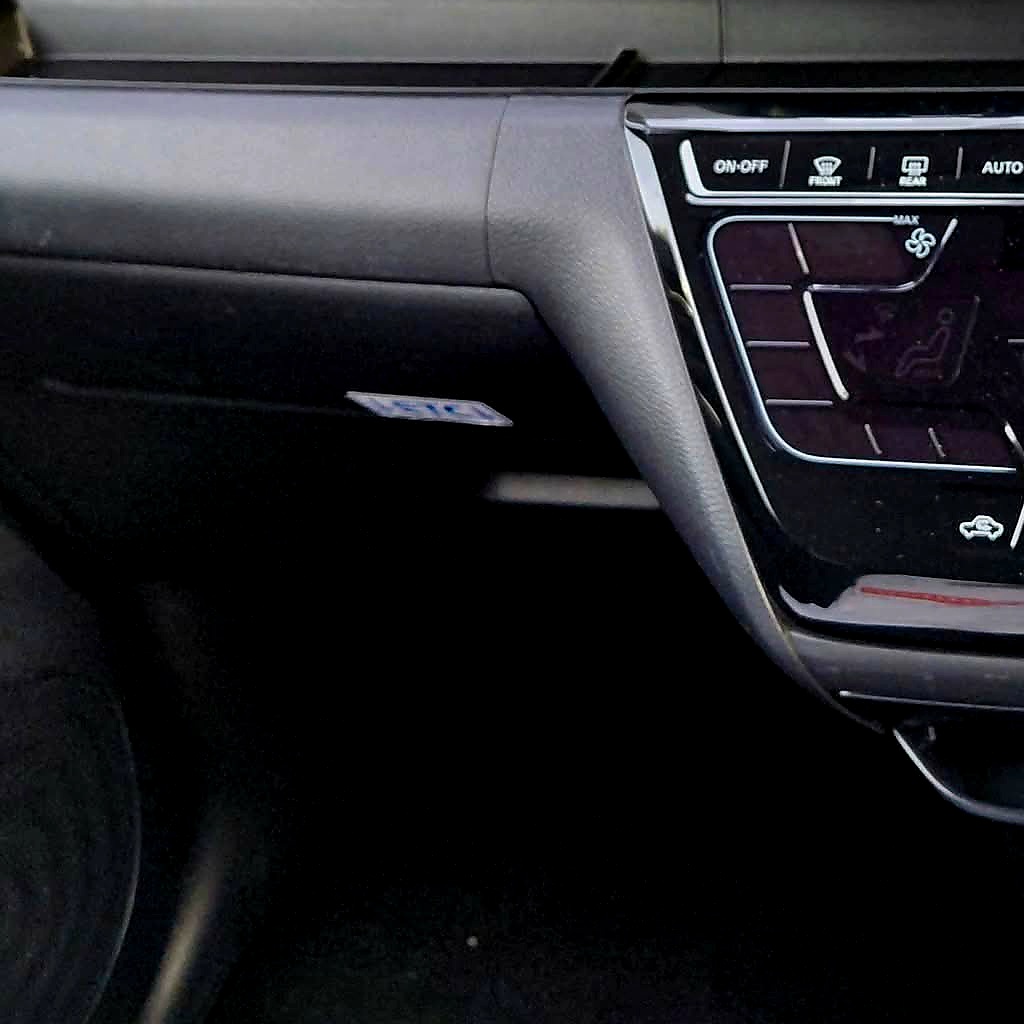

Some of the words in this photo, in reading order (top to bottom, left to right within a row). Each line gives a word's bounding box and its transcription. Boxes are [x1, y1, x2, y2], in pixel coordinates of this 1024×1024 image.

[982, 160, 1024, 175] AUTO
[808, 175, 843, 187] FRONT
[898, 175, 927, 187] REAR
